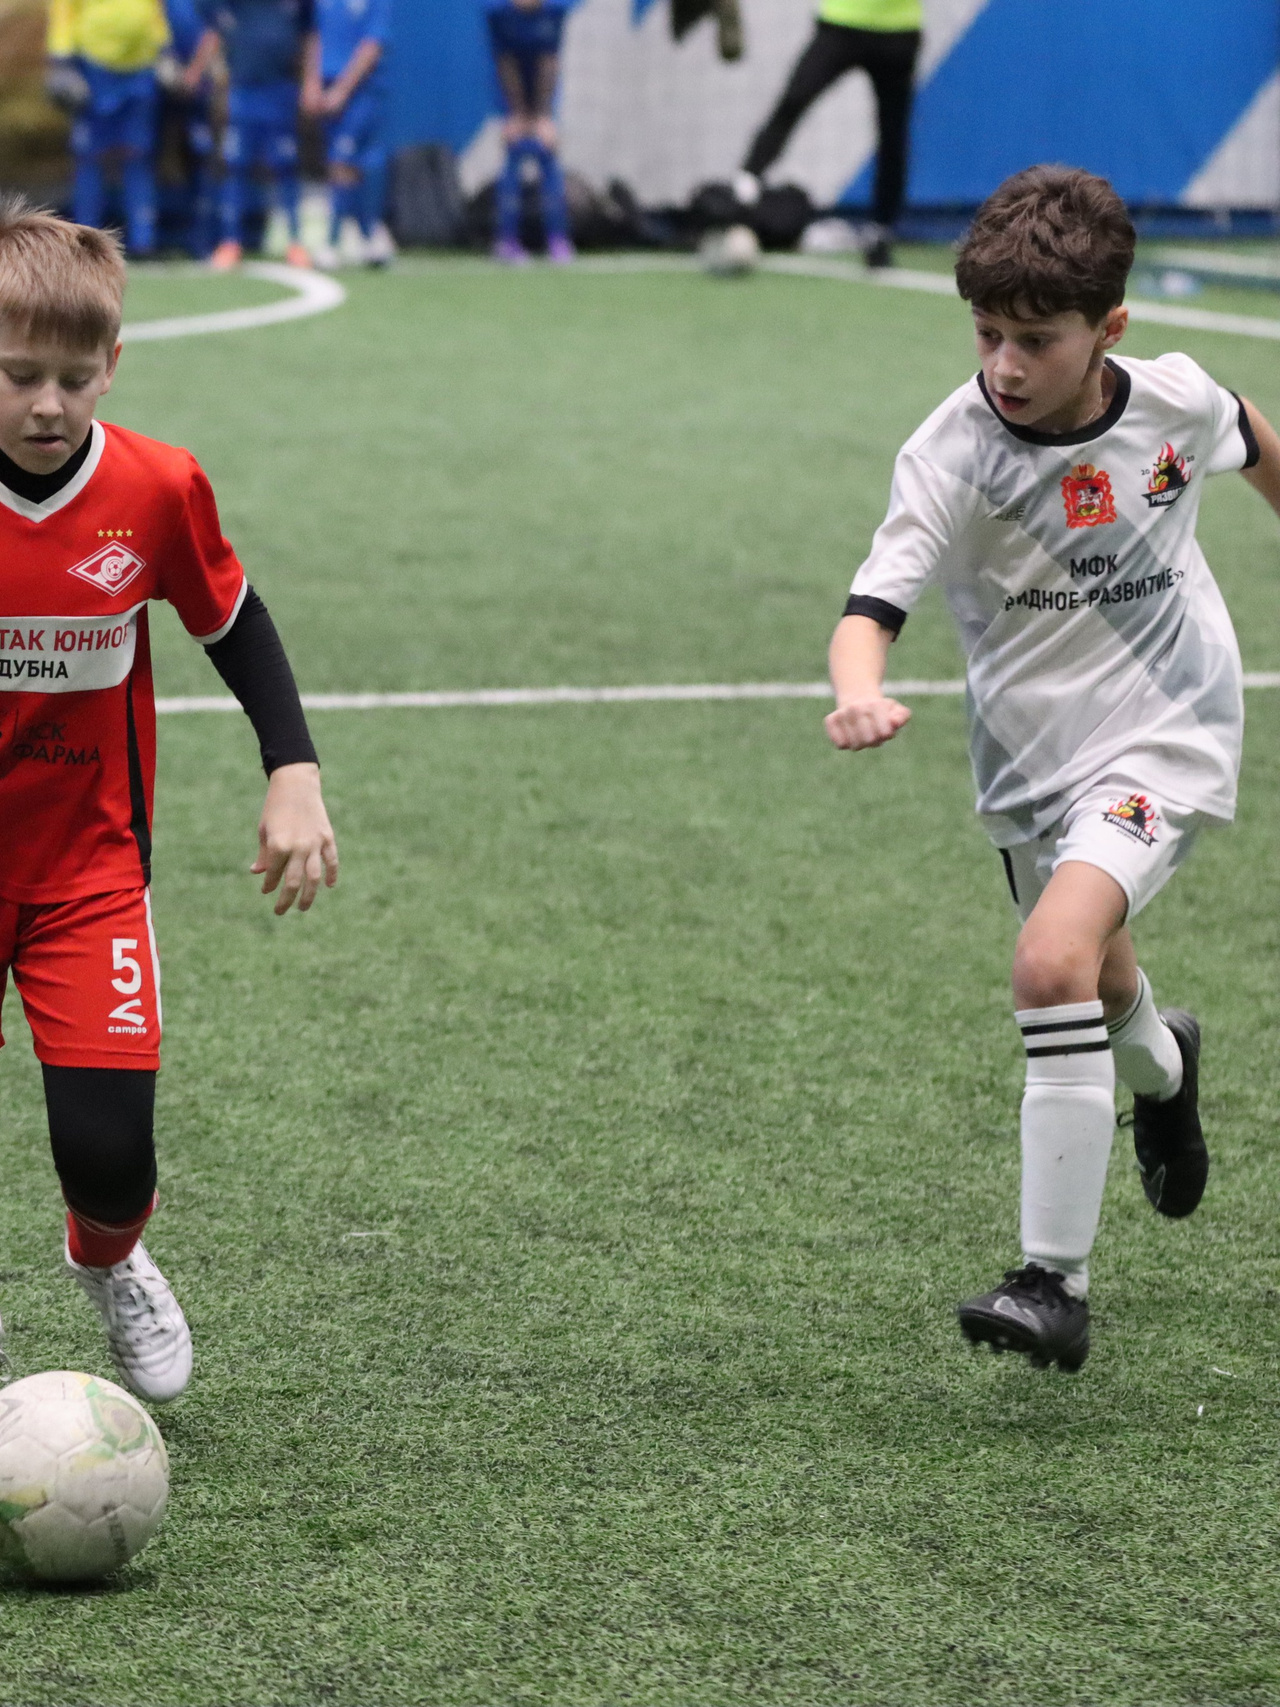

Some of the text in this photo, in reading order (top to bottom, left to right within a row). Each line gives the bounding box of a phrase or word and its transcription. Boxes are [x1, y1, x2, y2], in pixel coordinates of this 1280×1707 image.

[1070, 554, 1118, 578] МФК
[13, 743, 100, 765] ФАРМА
[111, 938, 142, 995] 5
[107, 1025, 147, 1035] campeo
